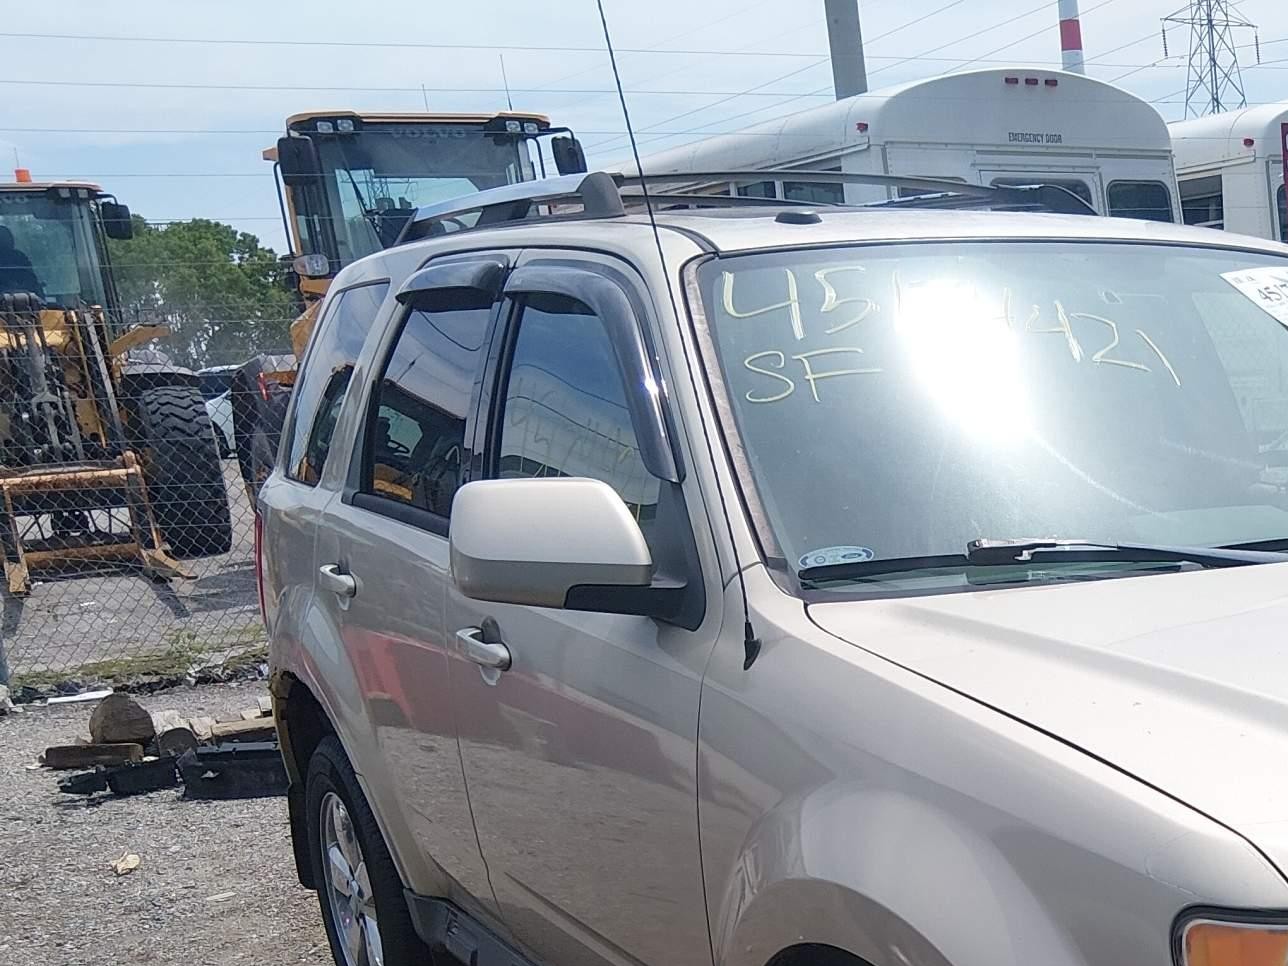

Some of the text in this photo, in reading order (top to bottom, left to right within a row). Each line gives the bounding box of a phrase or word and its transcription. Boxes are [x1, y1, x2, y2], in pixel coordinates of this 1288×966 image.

[1008, 132, 1063, 144] EMERGENCY DOOR
[745, 348, 883, 402] SF
